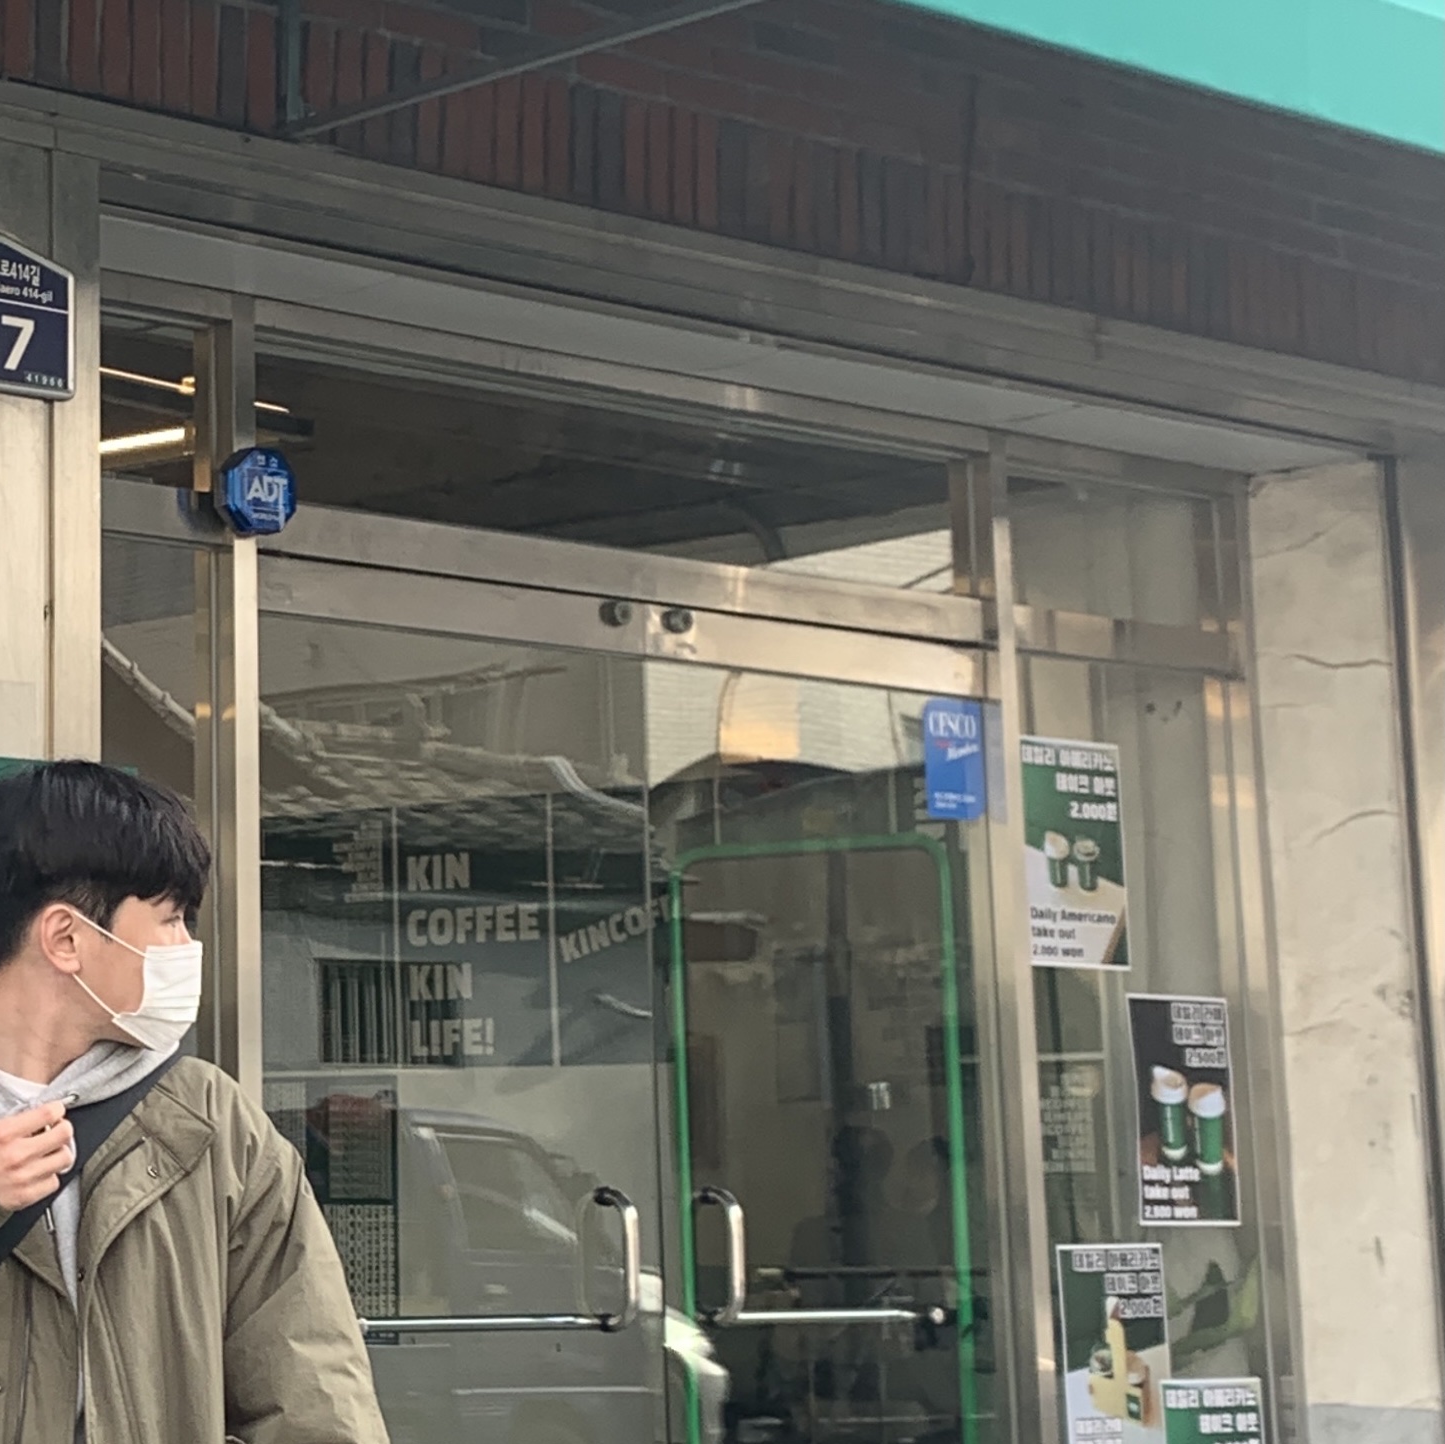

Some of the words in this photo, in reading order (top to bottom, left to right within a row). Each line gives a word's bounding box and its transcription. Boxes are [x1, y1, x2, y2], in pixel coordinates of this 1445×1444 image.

[22, 286, 54, 304] 414-gil
[246, 474, 289, 514] ADT
[928, 710, 976, 739] CESCO
[407, 852, 470, 891] KIN
[407, 903, 540, 947] COFFEE
[1030, 906, 1057, 923] Daily
[1061, 908, 1116, 925] Americano
[1031, 926, 1055, 938] take
[1059, 928, 1075, 940] out
[409, 962, 473, 1001] KIN
[411, 1017, 494, 1057] LIFE!
[1143, 1165, 1171, 1184] Daily
[1143, 1185, 1169, 1200] take
[1171, 1185, 1190, 1200] out
[1174, 1206, 1198, 1219] won
